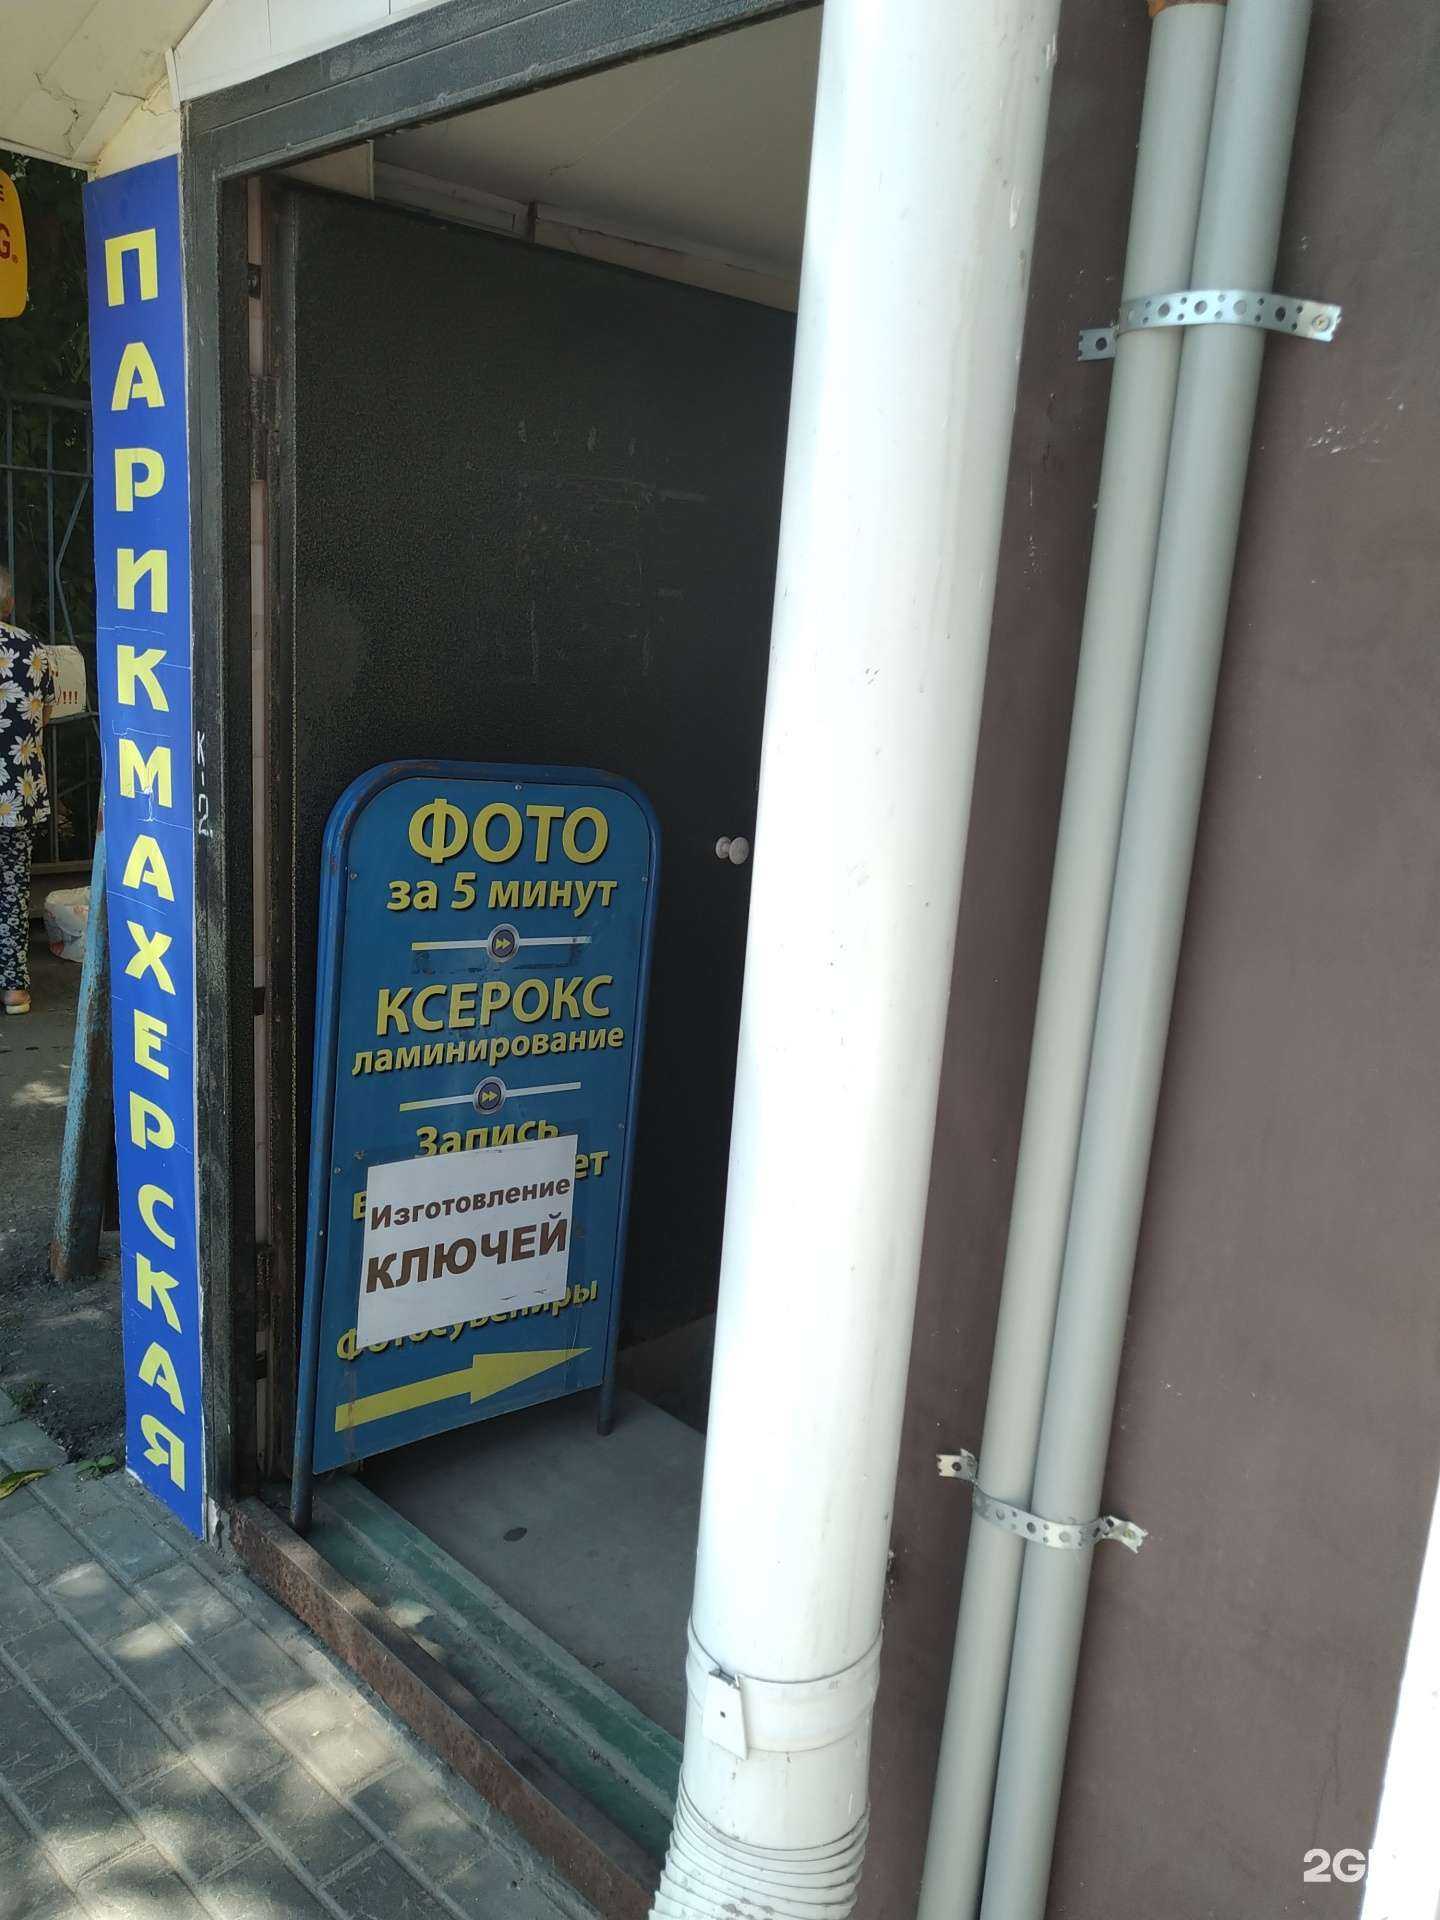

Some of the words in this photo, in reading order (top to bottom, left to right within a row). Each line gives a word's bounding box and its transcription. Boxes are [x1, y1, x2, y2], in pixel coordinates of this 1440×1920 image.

[103, 228, 187, 1491] ПАРИКМАХЕРСКАЯ
[408, 798, 609, 864] ФОТО
[386, 880, 439, 912] за
[450, 871, 478, 910] 5
[487, 880, 618, 918] минут
[375, 974, 614, 1037] КСЕРОКС
[351, 1026, 625, 1076] ламинирование
[415, 1119, 559, 1158] Запись
[370, 1177, 571, 1231] Изготовление
[365, 1211, 568, 1294] КЛЮЧЕЙ
